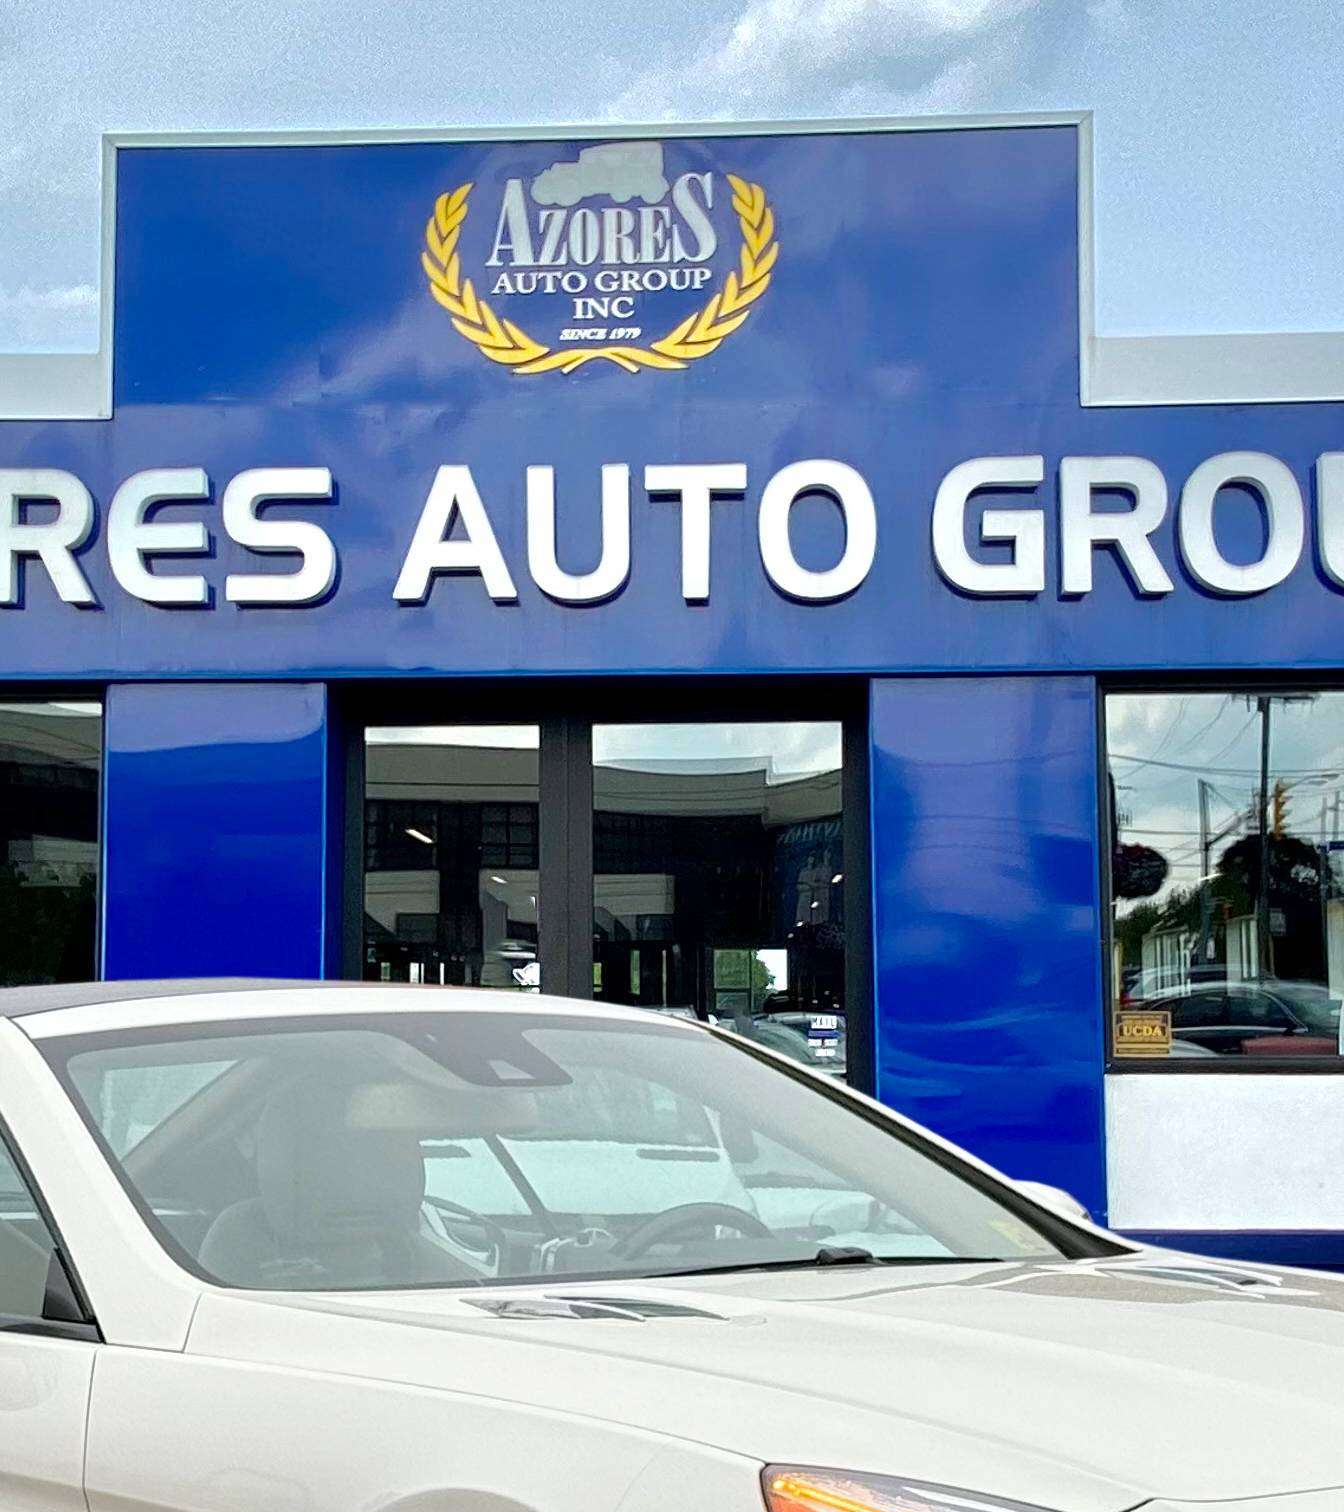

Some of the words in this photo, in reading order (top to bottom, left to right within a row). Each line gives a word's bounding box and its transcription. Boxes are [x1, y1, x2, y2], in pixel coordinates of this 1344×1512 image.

[485, 172, 717, 267] AZORES
[491, 271, 587, 295] AUTO
[594, 268, 713, 293] GROUP
[572, 296, 635, 319] INC
[559, 328, 608, 341] SINCE
[392, 458, 879, 605] AUTO
[1122, 1024, 1162, 1038] UCDA
